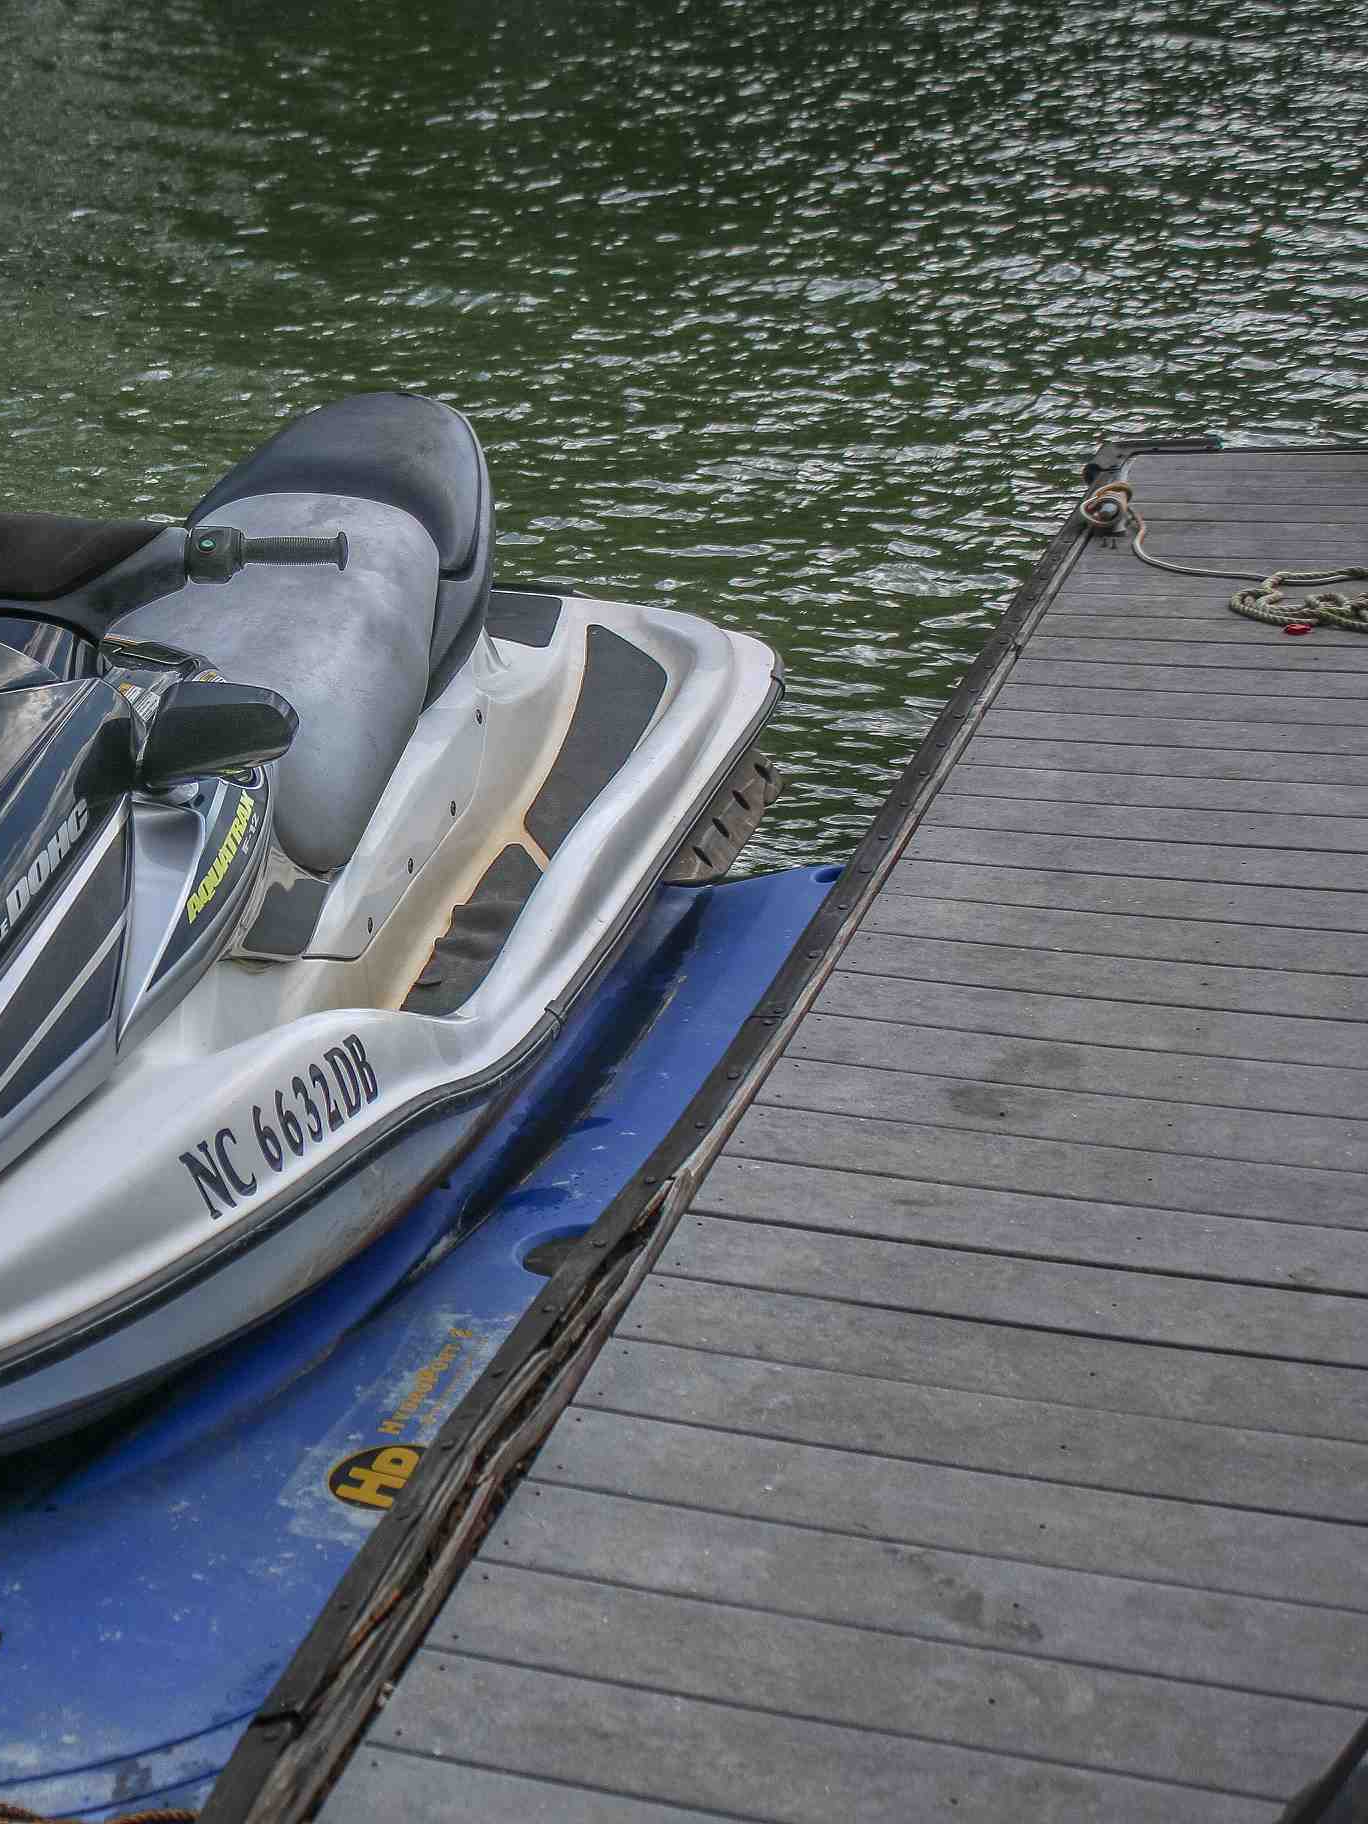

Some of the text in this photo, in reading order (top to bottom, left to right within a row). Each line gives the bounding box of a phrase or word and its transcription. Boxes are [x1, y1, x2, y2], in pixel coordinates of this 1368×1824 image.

[5, 798, 89, 927] DOHC
[187, 788, 255, 924] AQUATRAX
[179, 1033, 379, 1220] NC 6632DB
